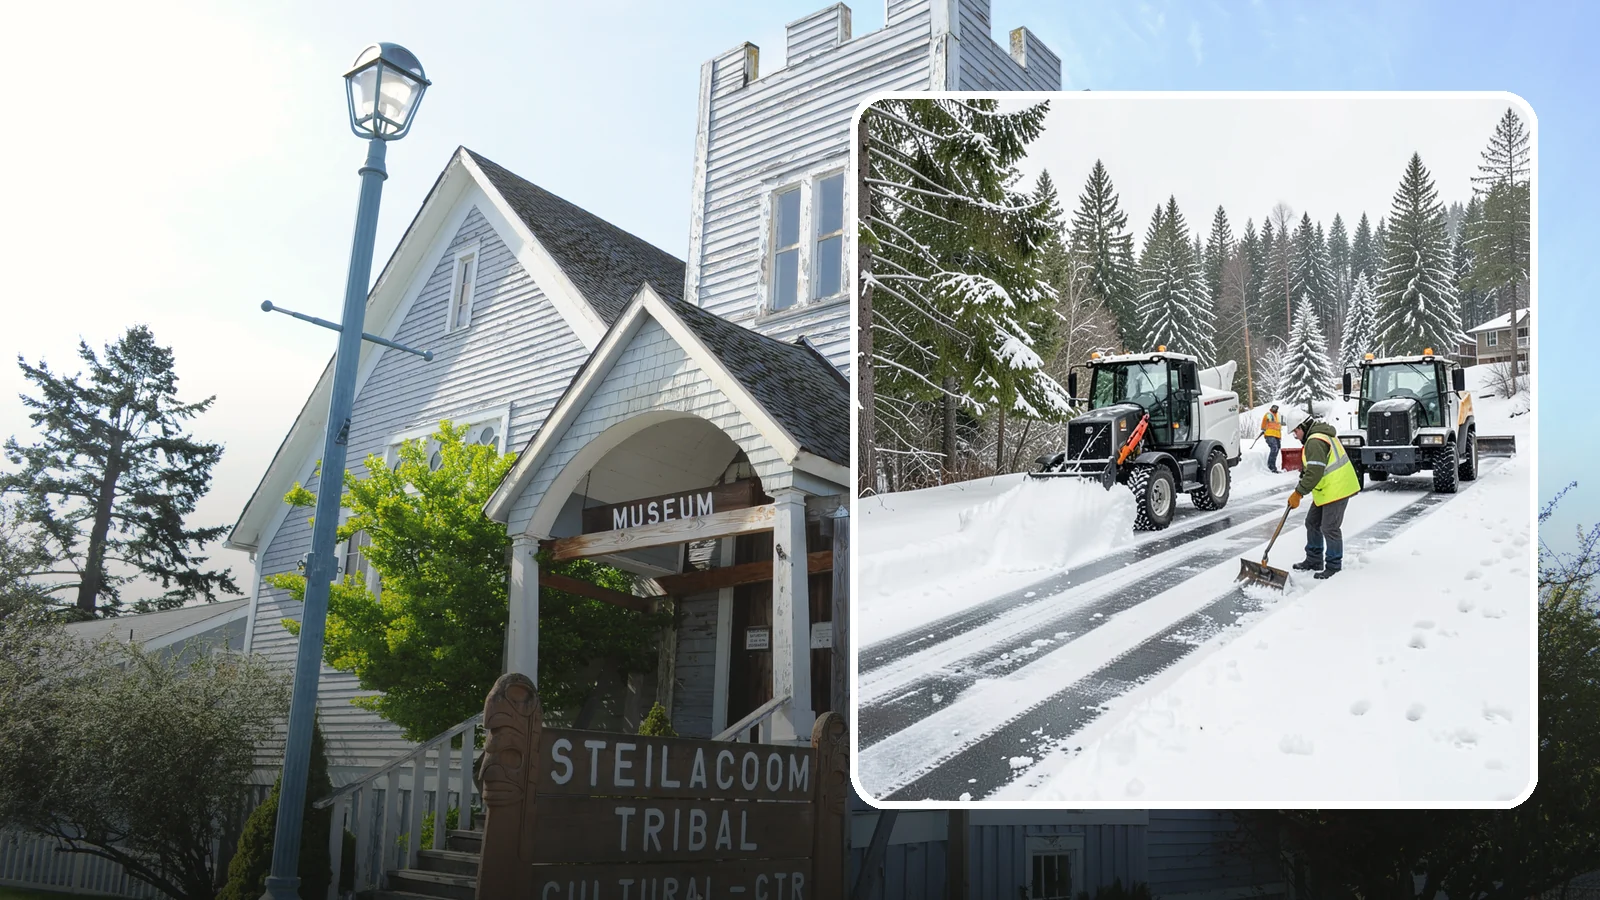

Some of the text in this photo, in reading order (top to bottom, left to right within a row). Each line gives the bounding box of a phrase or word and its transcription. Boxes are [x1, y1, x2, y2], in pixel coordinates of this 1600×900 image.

[612, 491, 714, 530] MUSEUM
[551, 738, 810, 793] STEILACOOM
[615, 806, 758, 852] TRIBAL
